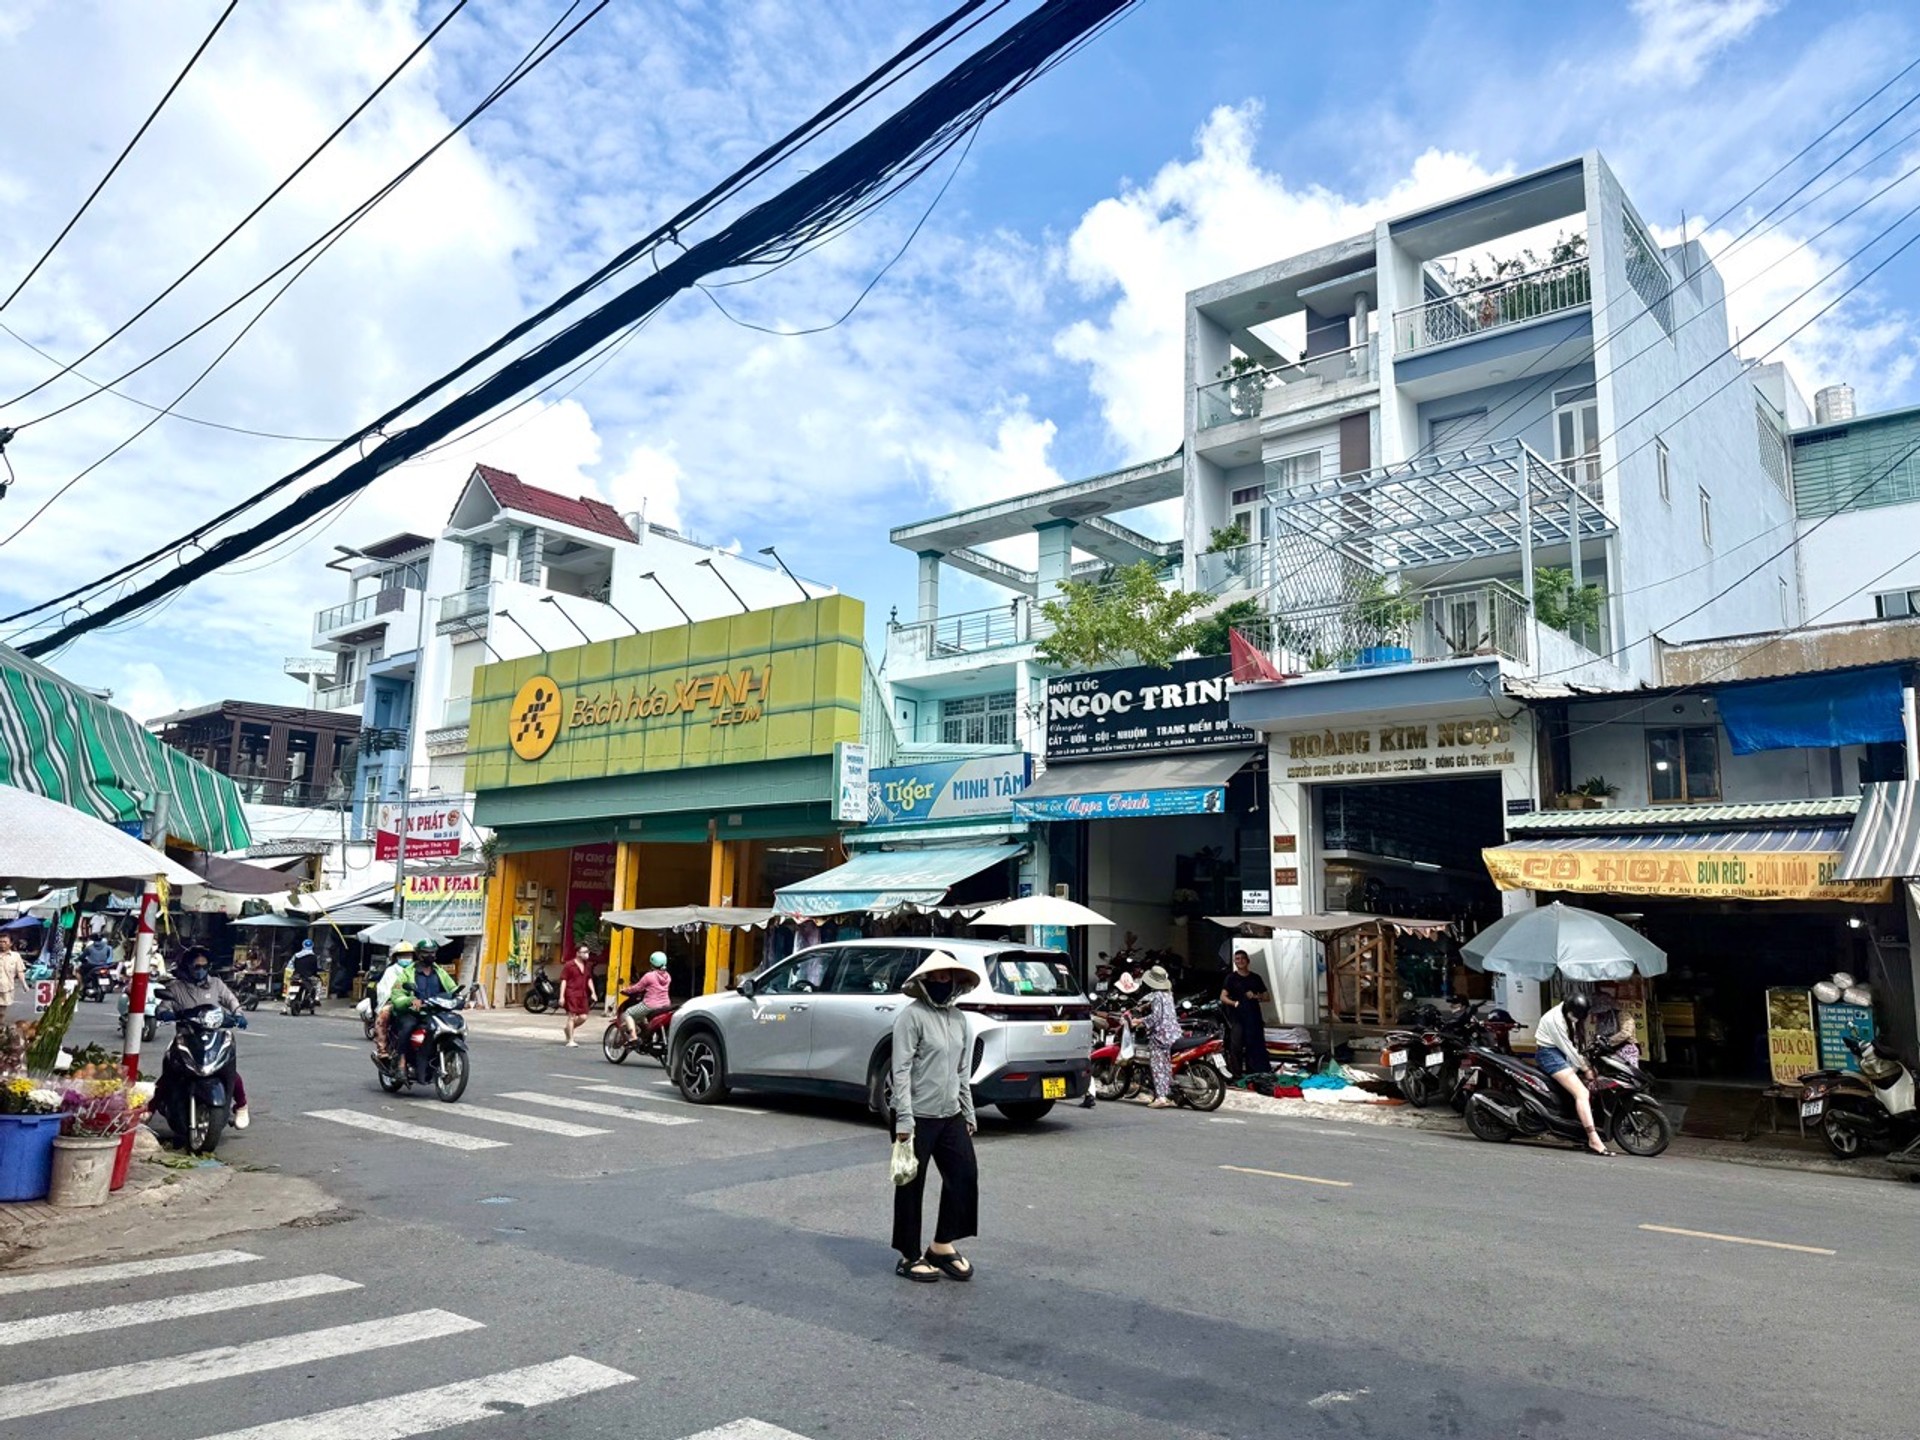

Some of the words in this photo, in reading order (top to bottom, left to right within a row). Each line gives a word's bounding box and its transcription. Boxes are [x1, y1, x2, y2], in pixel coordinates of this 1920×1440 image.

[569, 686, 622, 728] Bách
[625, 685, 668, 721] hóa
[667, 664, 772, 714] XANH
[1048, 679, 1072, 695] UỐN
[1074, 677, 1099, 691] TÓC
[1049, 690, 1133, 723] NGỌC
[1070, 731, 1087, 744] UỐN
[1095, 730, 1109, 743] GỘI
[1117, 727, 1147, 740] NHUỘM
[1156, 724, 1185, 736] TRANG
[1188, 719, 1212, 733] ĐIỂM
[1289, 728, 1370, 759] HOÀNG
[1379, 725, 1428, 752] KIM
[1437, 719, 1510, 750] NGỌC
[885, 776, 934, 811] Tiger
[953, 777, 989, 800] MINH
[993, 771, 1024, 796] TÂM
[394, 815, 415, 833] TN
[417, 810, 447, 832] PHÁT
[1522, 853, 1580, 883] CÔ
[1592, 859, 1694, 884] HOA
[1698, 855, 1719, 884] BÚN
[1721, 855, 1746, 885] RIÊU
[1756, 856, 1779, 885] BÚN
[1781, 855, 1808, 886] MẮM
[37, 982, 51, 1005] 3
